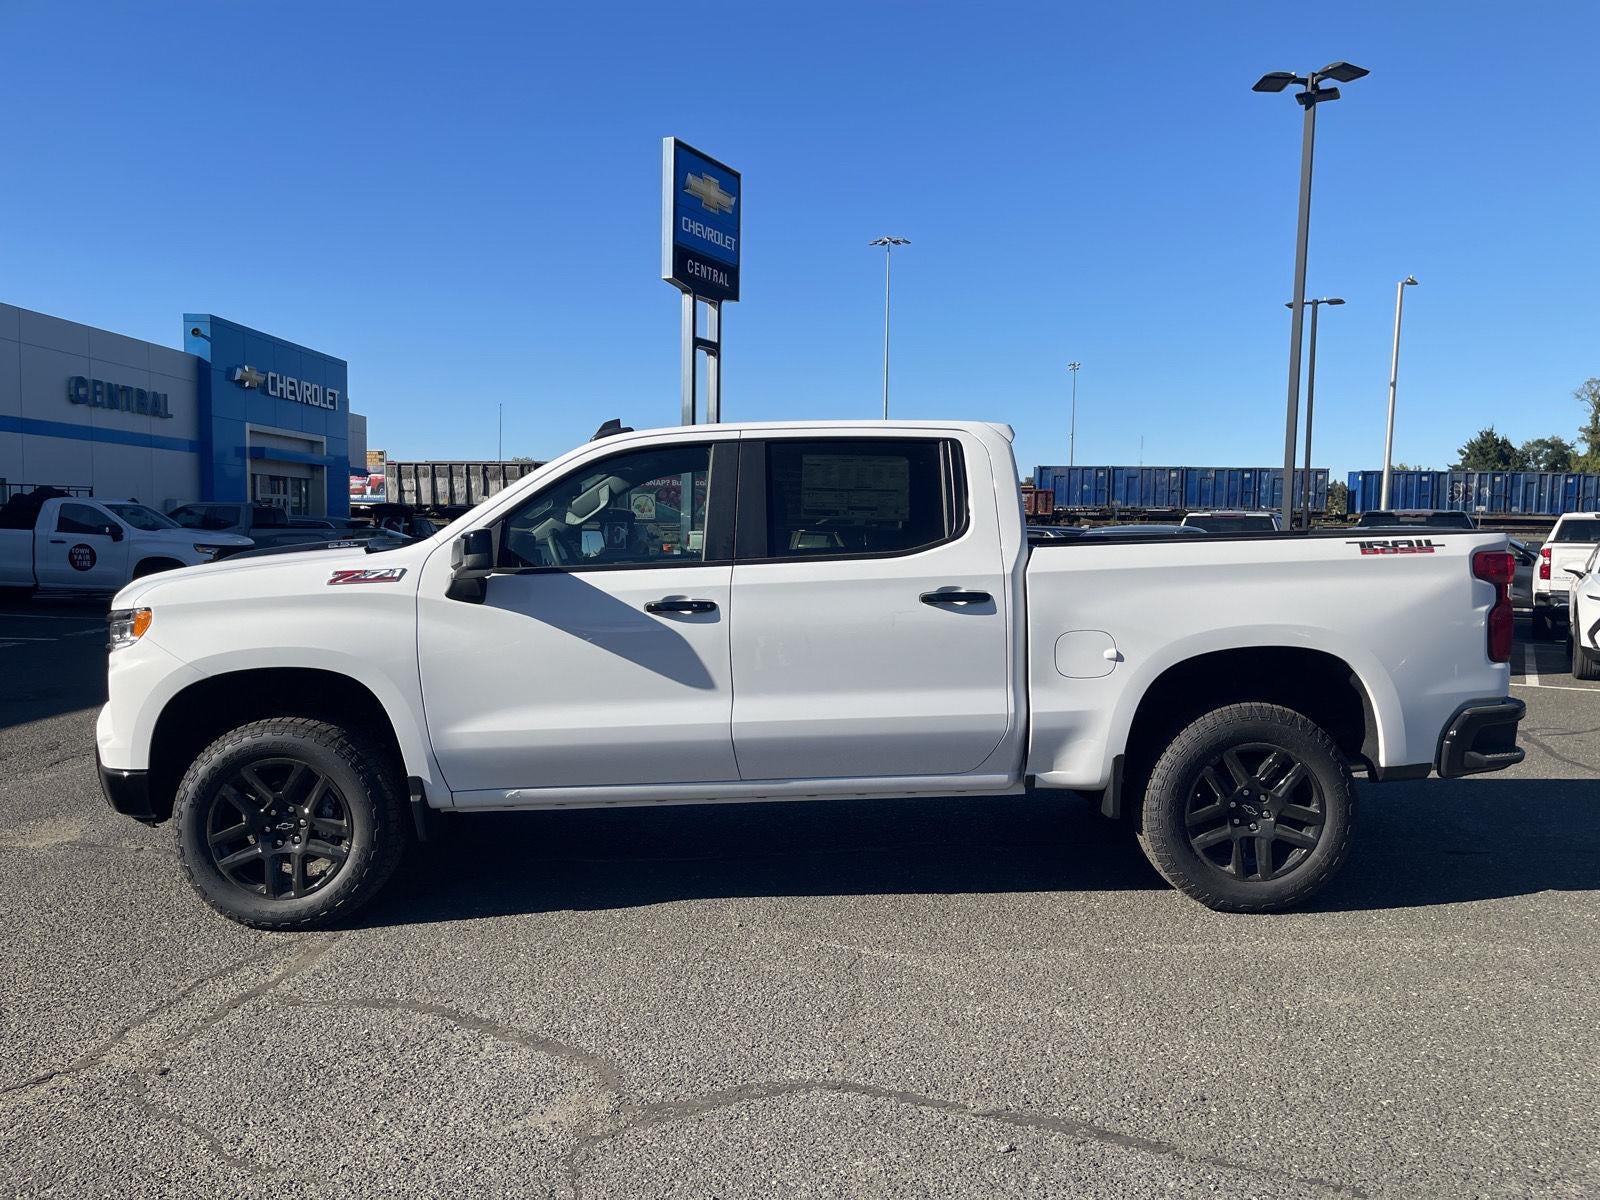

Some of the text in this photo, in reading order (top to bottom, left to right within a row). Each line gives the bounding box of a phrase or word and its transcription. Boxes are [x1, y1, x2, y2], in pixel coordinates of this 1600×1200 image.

[682, 216, 736, 251] CHEVROLET
[687, 259, 730, 287] CENTRAL
[68, 376, 173, 418] CENTRAL
[268, 371, 340, 411] CHEVROLET
[1346, 539, 1445, 549] TRAIL
[327, 568, 408, 585] Z71
